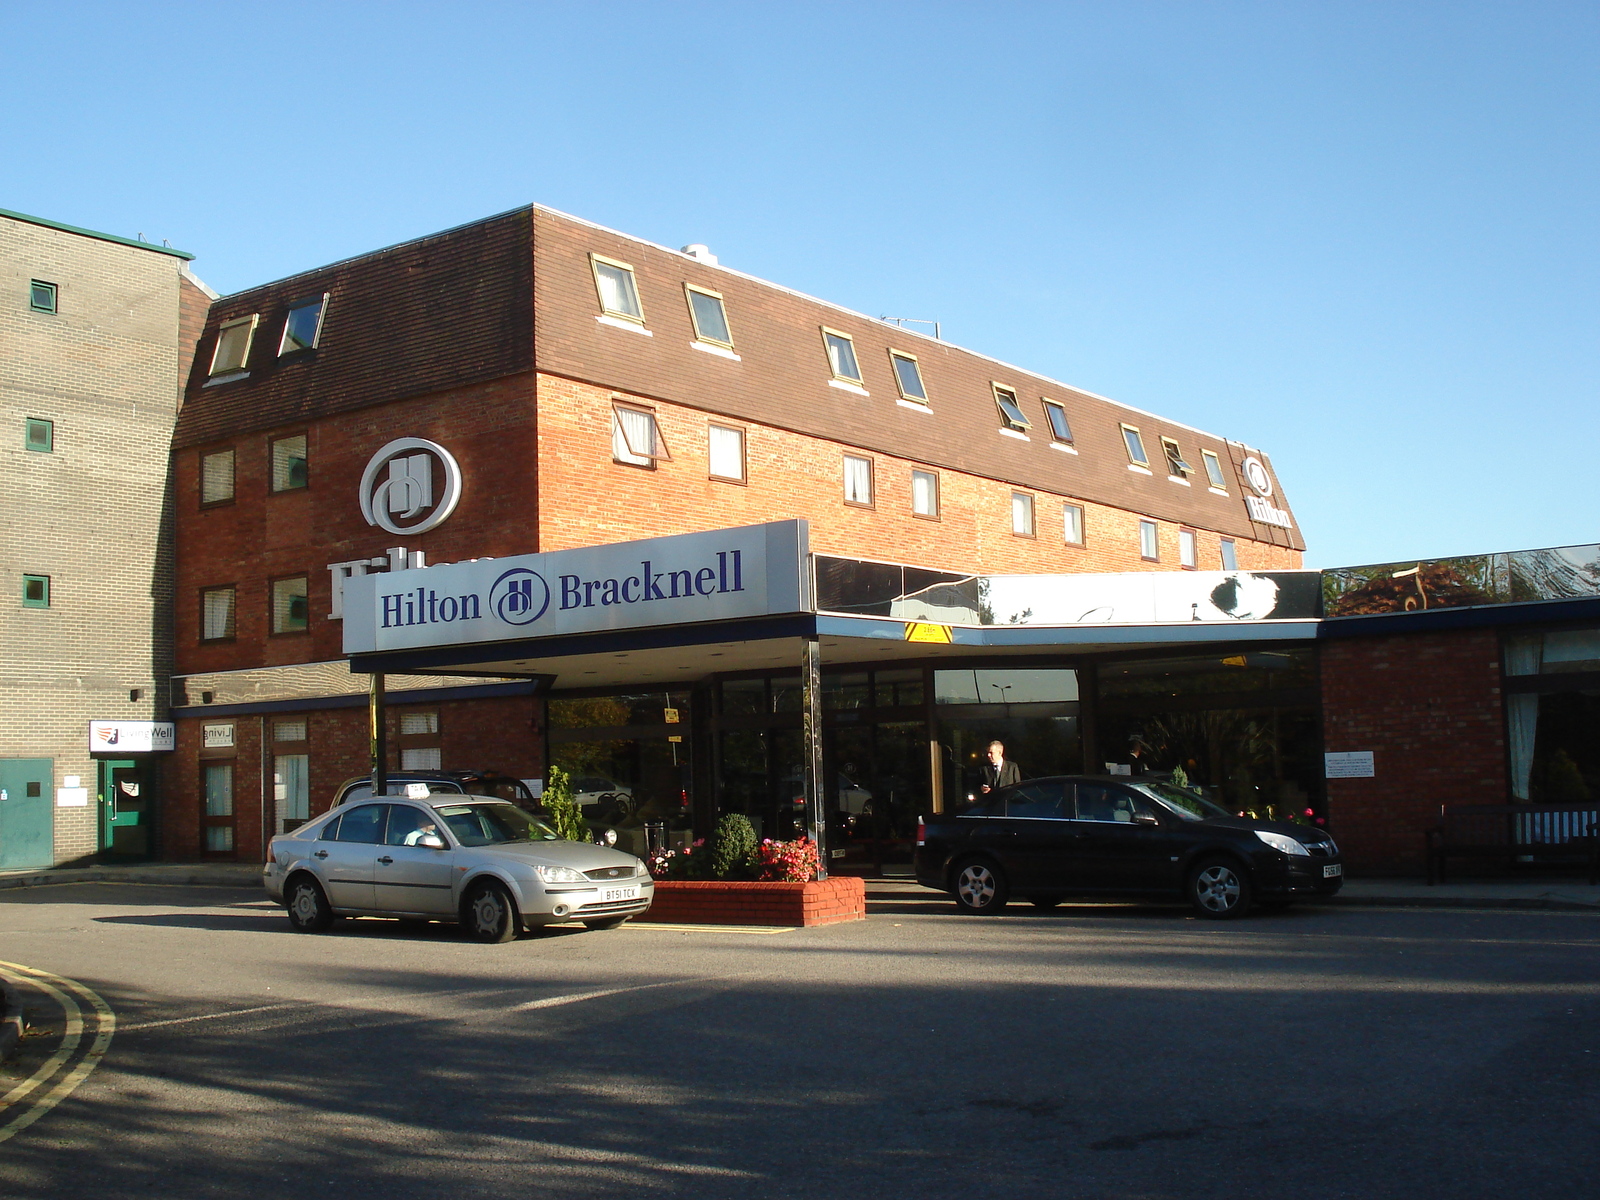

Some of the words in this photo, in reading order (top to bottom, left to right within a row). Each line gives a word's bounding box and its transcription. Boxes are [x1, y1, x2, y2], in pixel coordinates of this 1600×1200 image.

[1244, 495, 1293, 529] Hilton
[381, 587, 482, 629] Hilton
[558, 549, 745, 611] Bracknell
[606, 889, 622, 900] BT51
